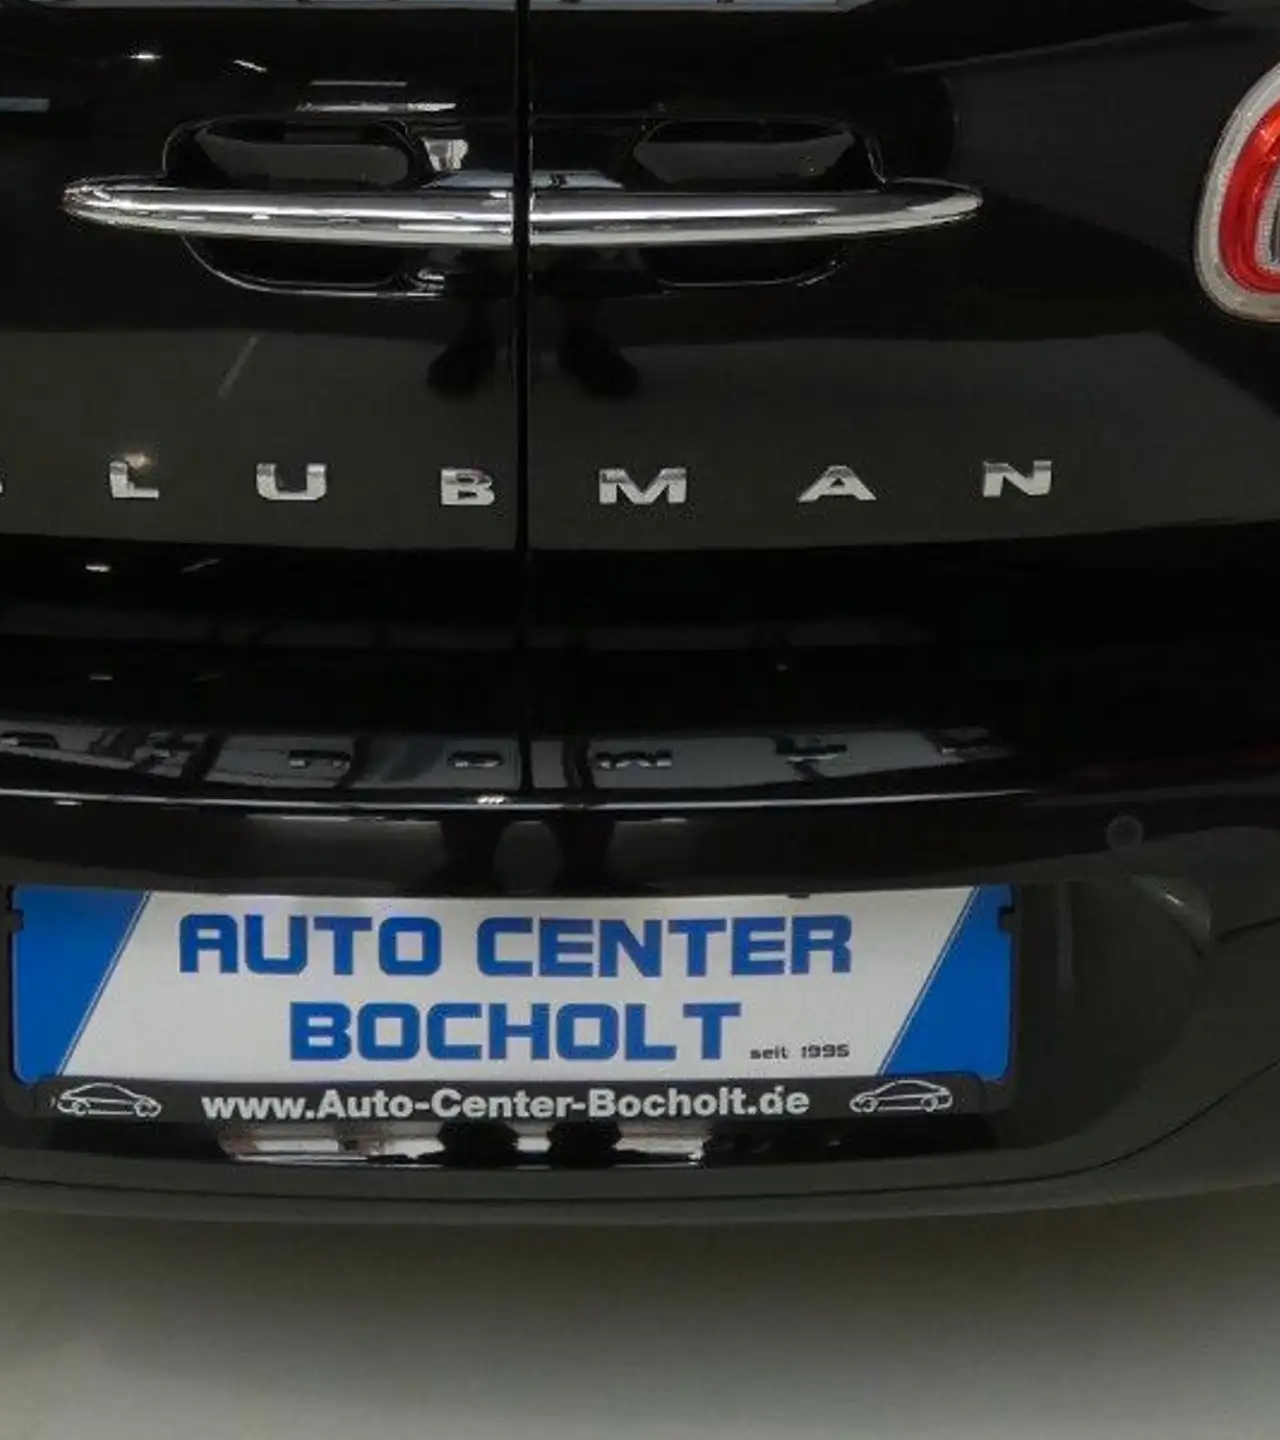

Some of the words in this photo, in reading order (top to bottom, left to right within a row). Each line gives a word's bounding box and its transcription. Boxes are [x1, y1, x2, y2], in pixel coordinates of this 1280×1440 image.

[177, 913, 445, 976] AUTO
[474, 914, 854, 978] CENTER
[286, 1001, 743, 1064] BOCHOLT
[749, 1045, 789, 1060] seit
[801, 1043, 851, 1059] 1995
[200, 1085, 810, 1122] www.Auto-Center-Bocholt.de
